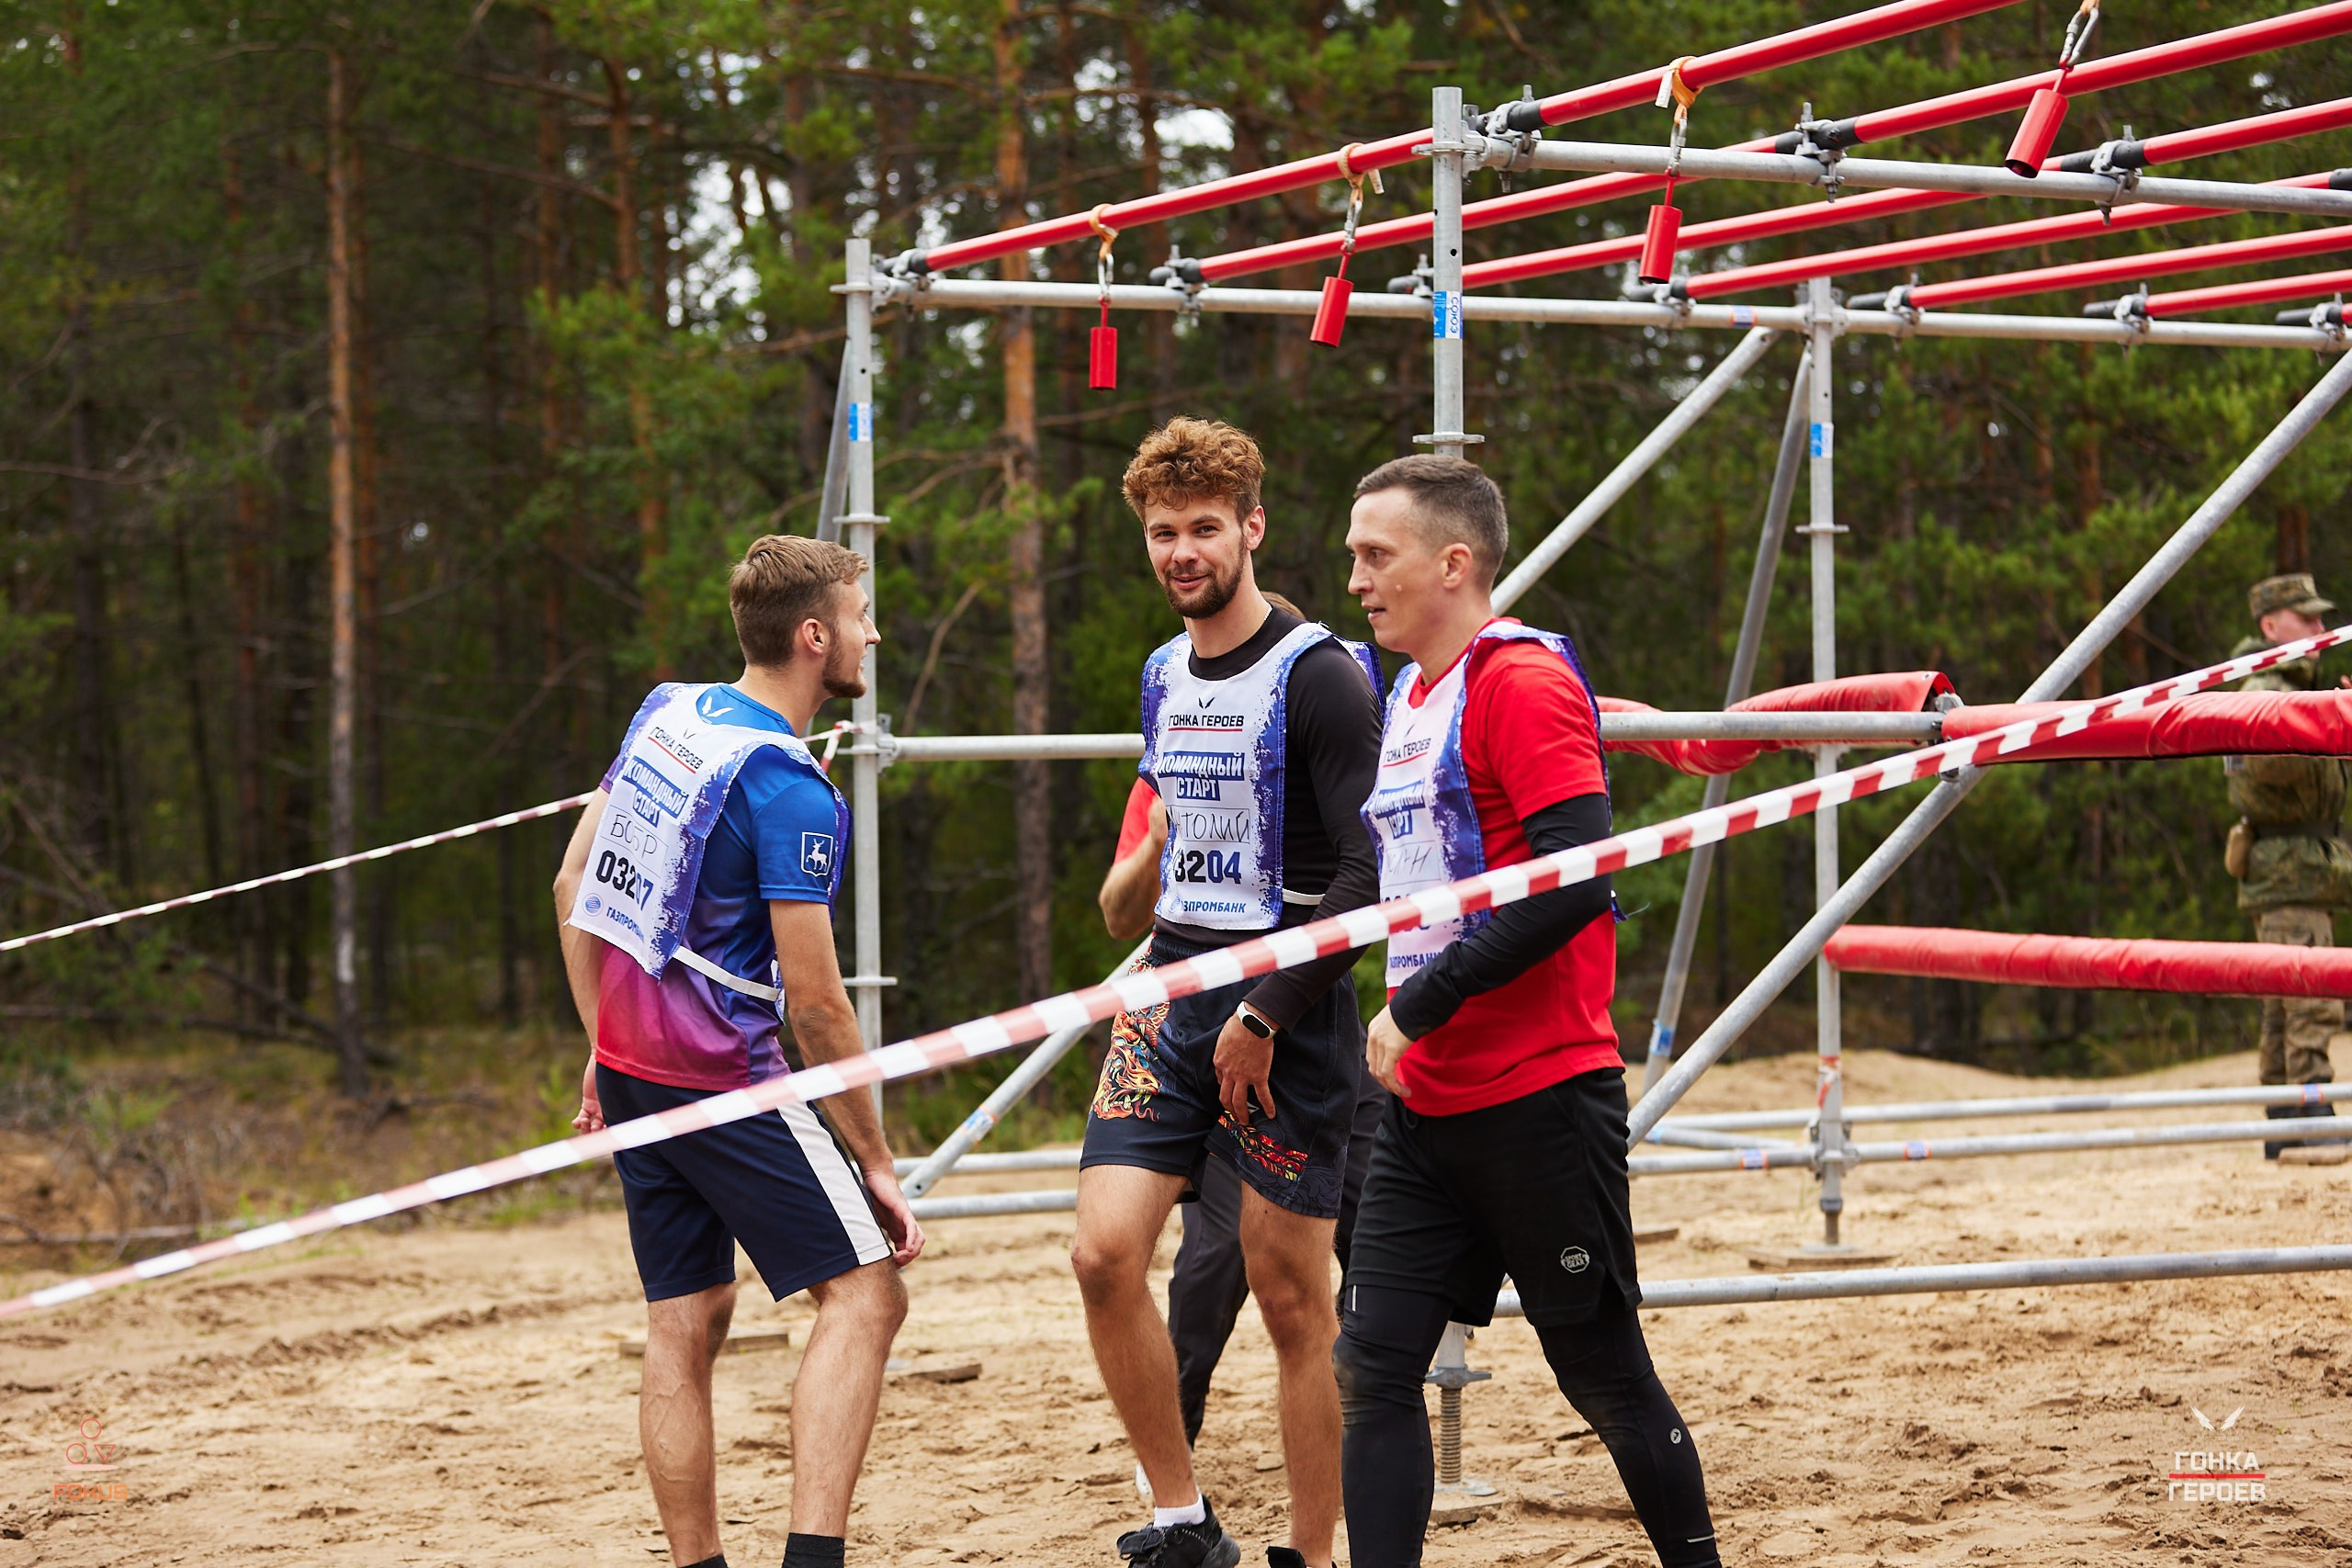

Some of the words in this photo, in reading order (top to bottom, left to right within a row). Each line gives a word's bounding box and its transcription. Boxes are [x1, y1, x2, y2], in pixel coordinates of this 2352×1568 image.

[1169, 714, 1198, 727] ГОНКА
[1202, 715, 1244, 727] ГЕРОЕВ
[650, 727, 675, 750] ГОНКА
[673, 743, 704, 770] ГЕРОЕВ
[1404, 738, 1431, 757] ГЕРОЕВ
[1159, 751, 1242, 778] КОМАНДНЫЙ
[625, 759, 688, 815] КОМАНДНЫЙ
[1177, 777, 1216, 798] СТАРТ
[634, 790, 660, 824] СТАРТ
[596, 850, 653, 911] 03207
[1173, 849, 1241, 885] 3204
[1181, 900, 1247, 913] ЗПРОМБАНК
